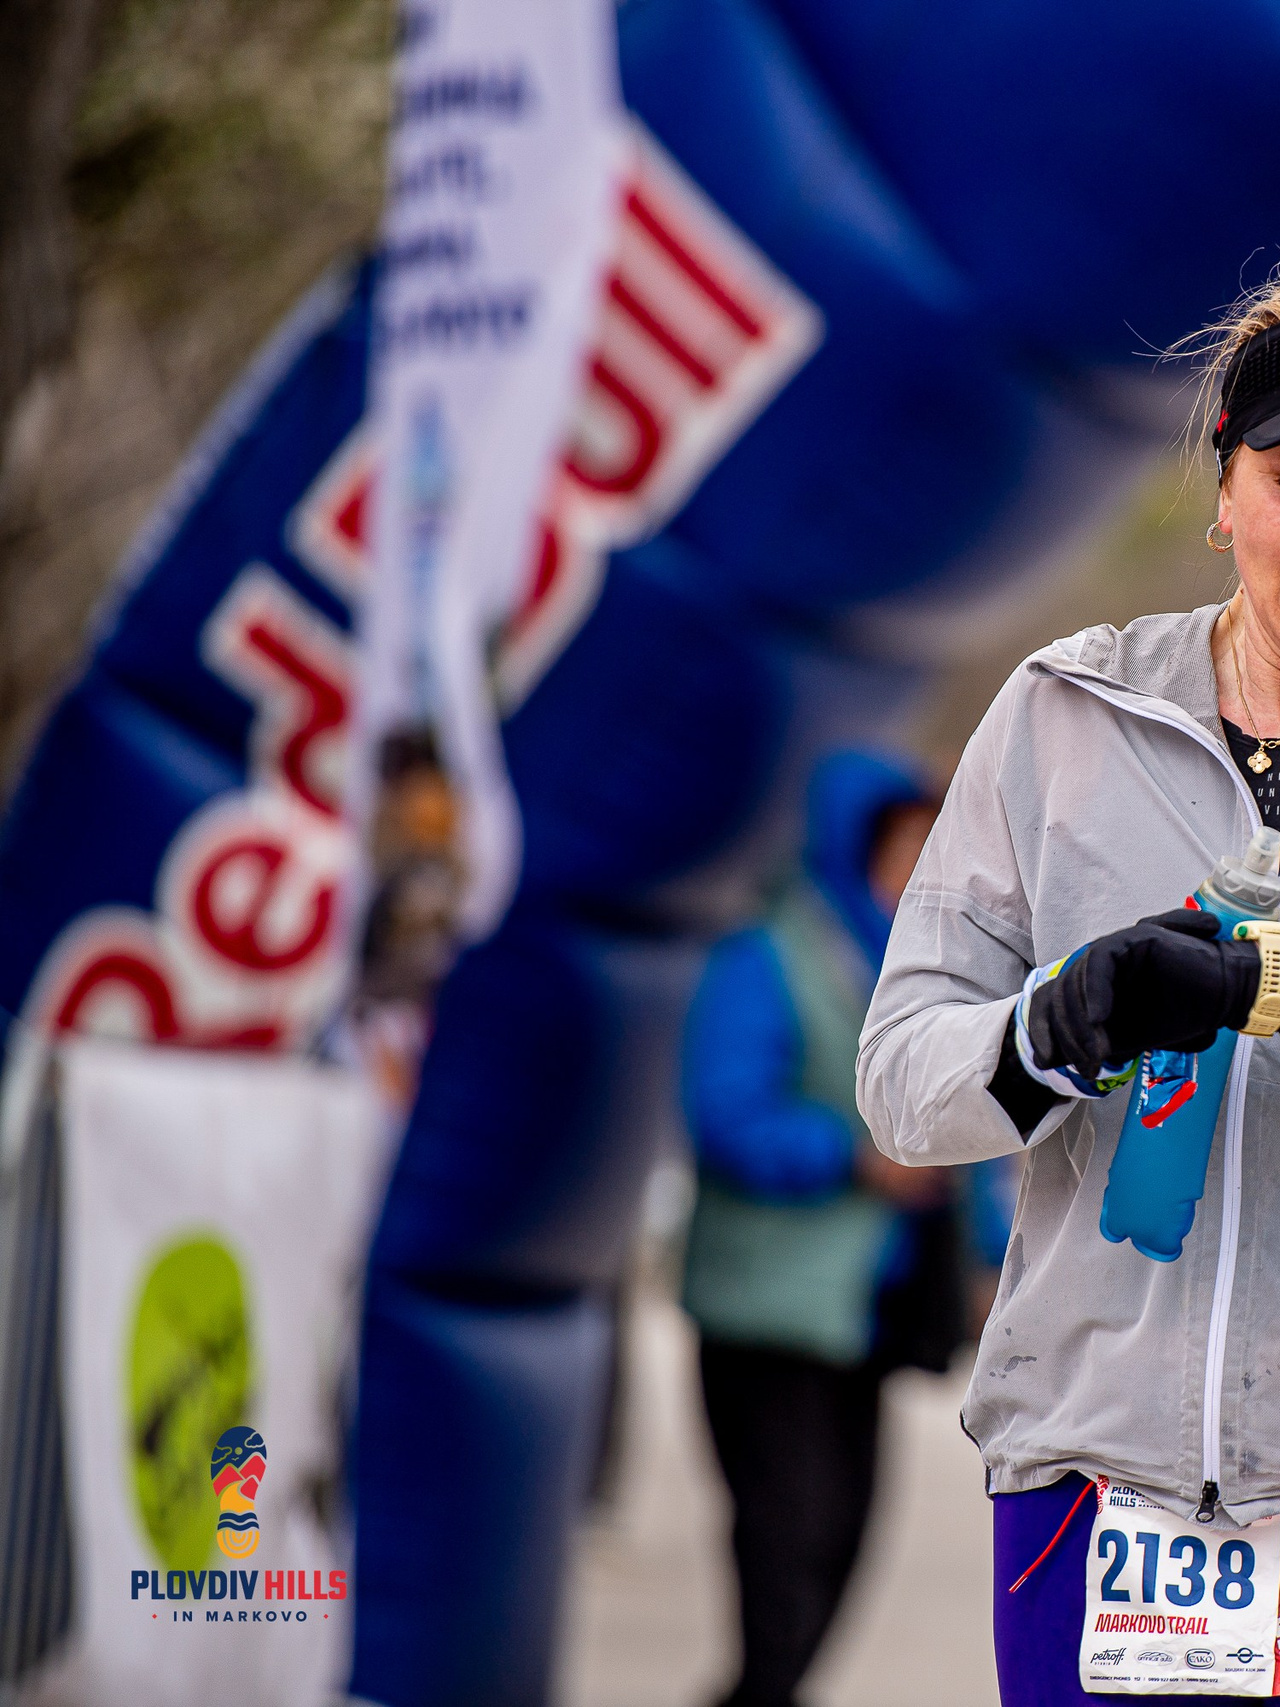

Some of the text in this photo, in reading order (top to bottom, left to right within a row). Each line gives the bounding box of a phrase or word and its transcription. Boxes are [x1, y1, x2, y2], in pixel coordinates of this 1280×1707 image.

[1111, 1486, 1146, 1498] PLOV
[1109, 1495, 1137, 1508] HILLS
[1097, 1528, 1256, 1610] 2138
[1094, 1613, 1210, 1635] MARKOVO TRAIL
